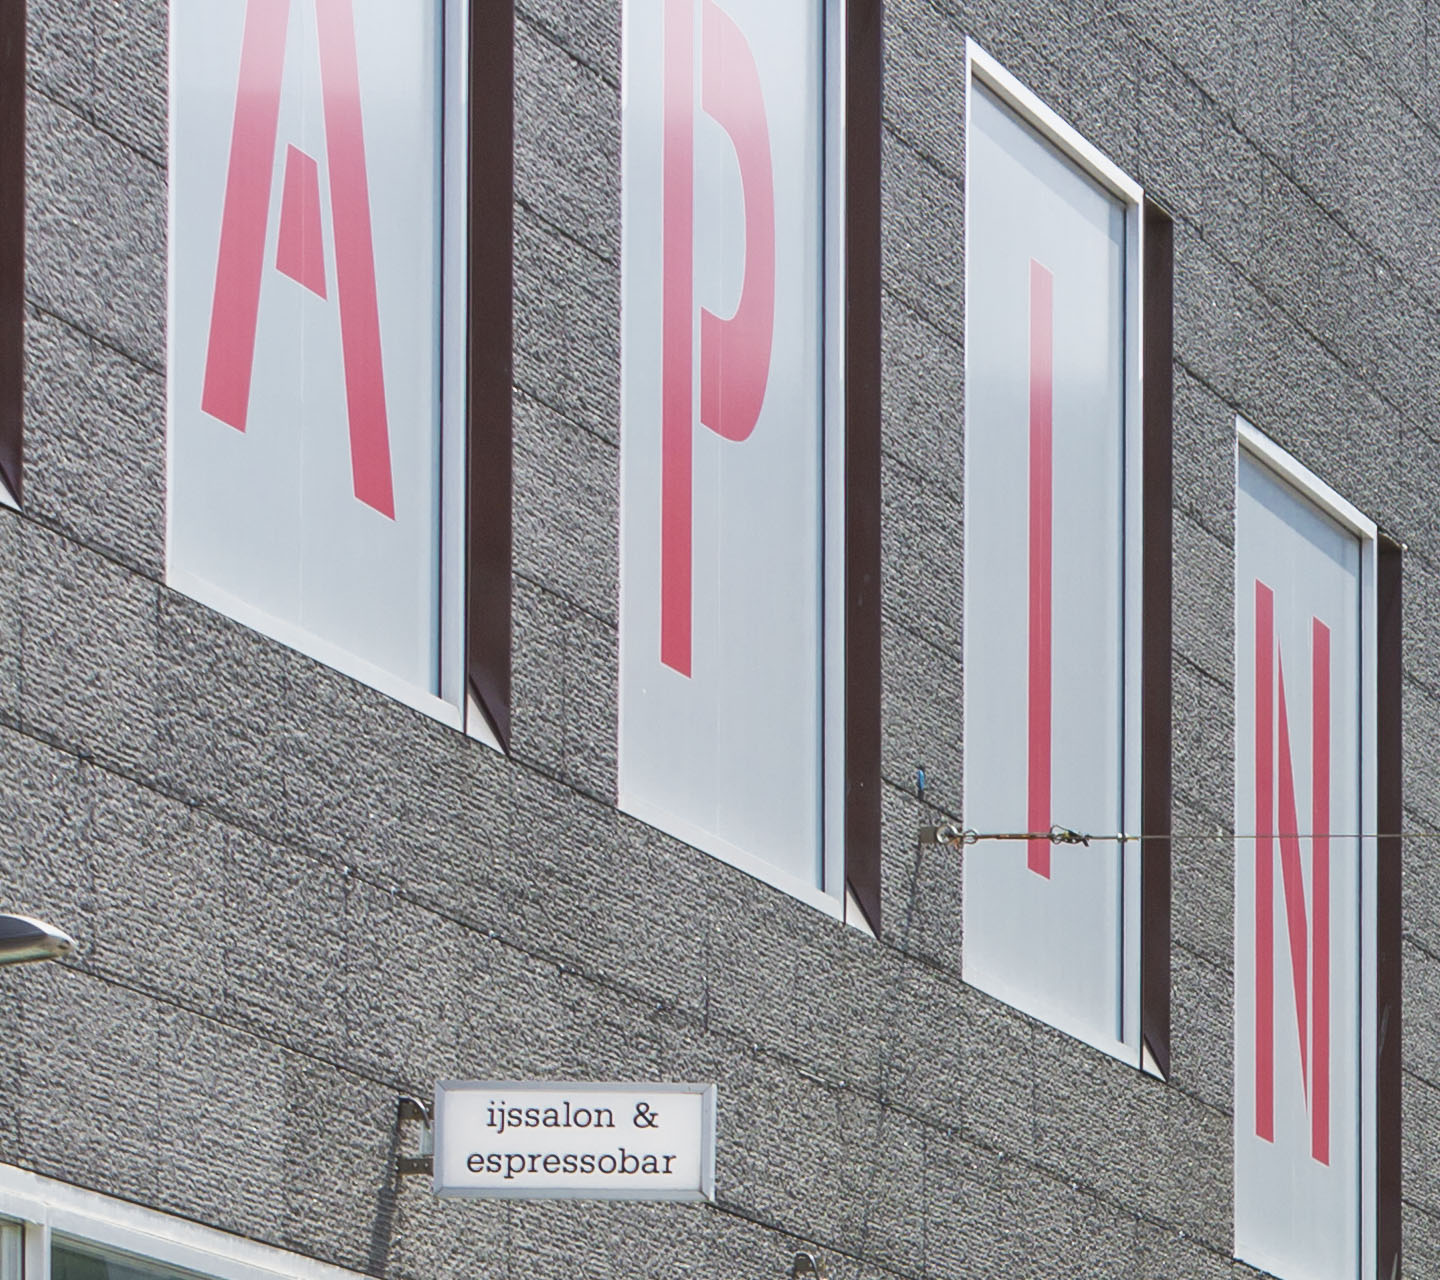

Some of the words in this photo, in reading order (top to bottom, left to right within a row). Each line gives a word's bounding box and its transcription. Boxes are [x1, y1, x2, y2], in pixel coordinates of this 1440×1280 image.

[486, 1101, 616, 1134] ijssalon
[633, 1102, 660, 1129] &
[467, 1148, 677, 1179] espressobar
